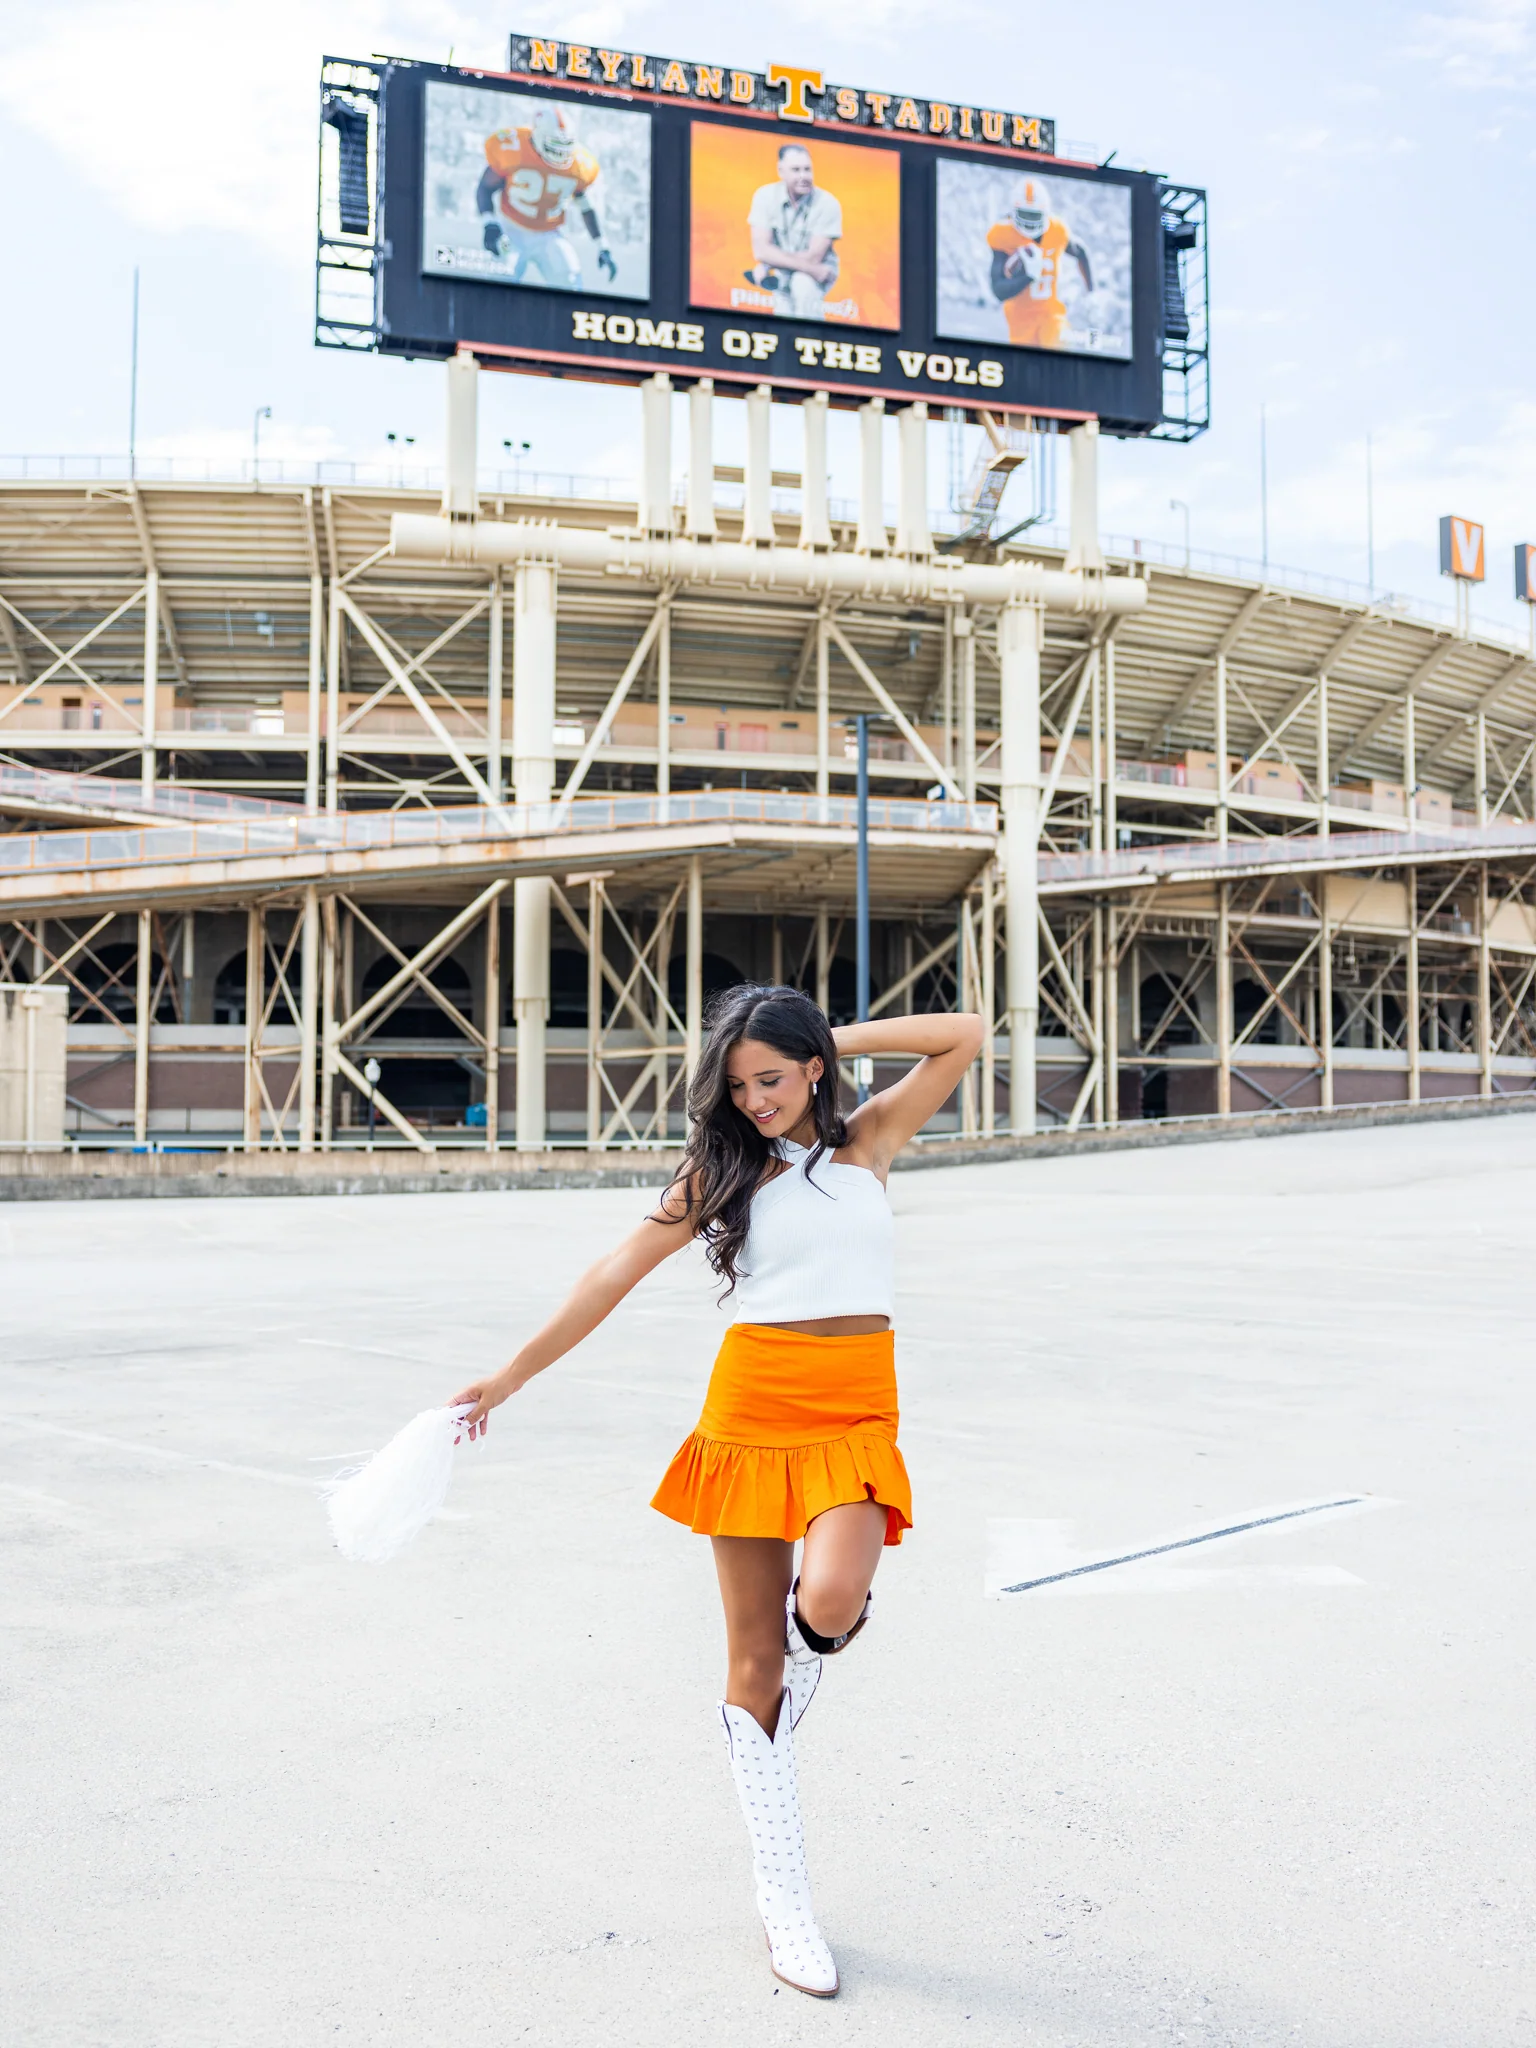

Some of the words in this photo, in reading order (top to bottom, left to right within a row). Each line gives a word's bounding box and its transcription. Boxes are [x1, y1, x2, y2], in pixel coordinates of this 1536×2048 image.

[529, 38, 755, 104] NEYLAND
[765, 62, 825, 124] T
[836, 87, 1042, 148] STADIUM
[508, 168, 578, 220] 27
[572, 310, 705, 353] HOME
[722, 328, 779, 361] OF
[794, 336, 882, 374] THE
[896, 349, 1005, 388] VOLS
[1453, 519, 1482, 574] V
